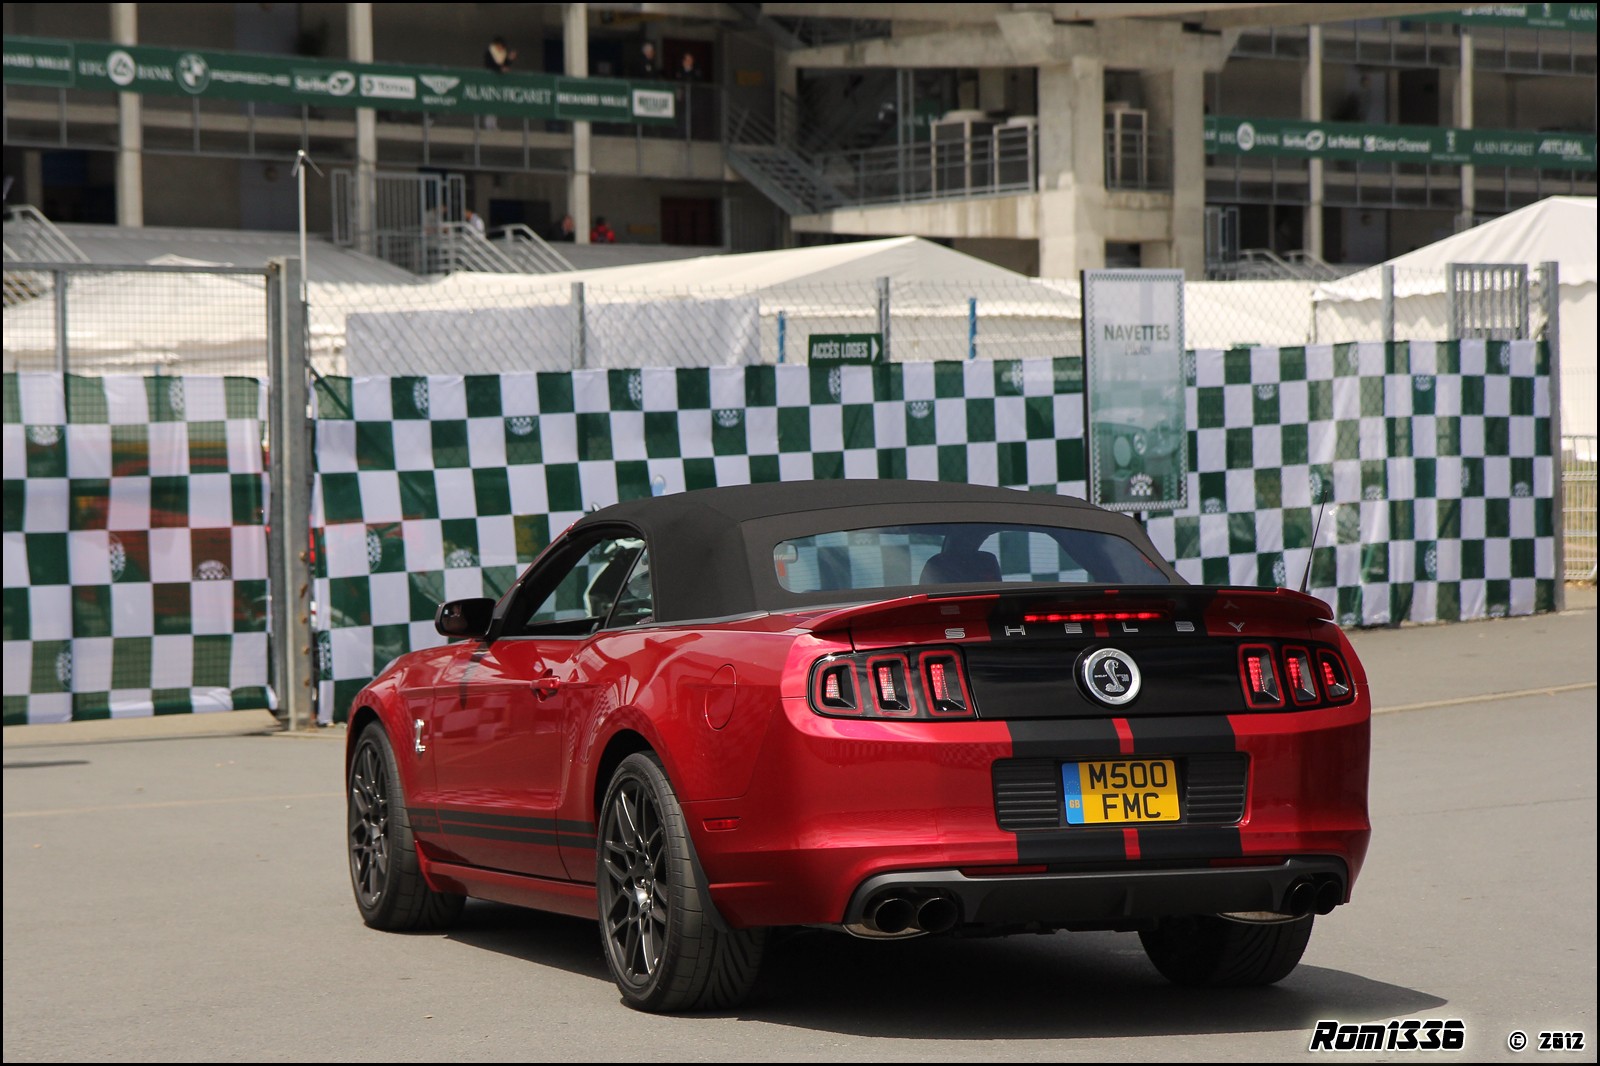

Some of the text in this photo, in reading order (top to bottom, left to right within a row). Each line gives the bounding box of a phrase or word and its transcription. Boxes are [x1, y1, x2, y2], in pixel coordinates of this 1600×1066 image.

[138, 64, 173, 82] BANK
[463, 84, 500, 101] ALAIN
[1473, 141, 1499, 155] ALAIN
[1104, 324, 1170, 341] NAVETTES
[811, 340, 868, 359] ACCÈS LOGES
[944, 620, 1246, 640] SHELBY
[1088, 761, 1168, 790] M500
[1069, 799, 1080, 809] GB
[1101, 792, 1161, 820] FMC
